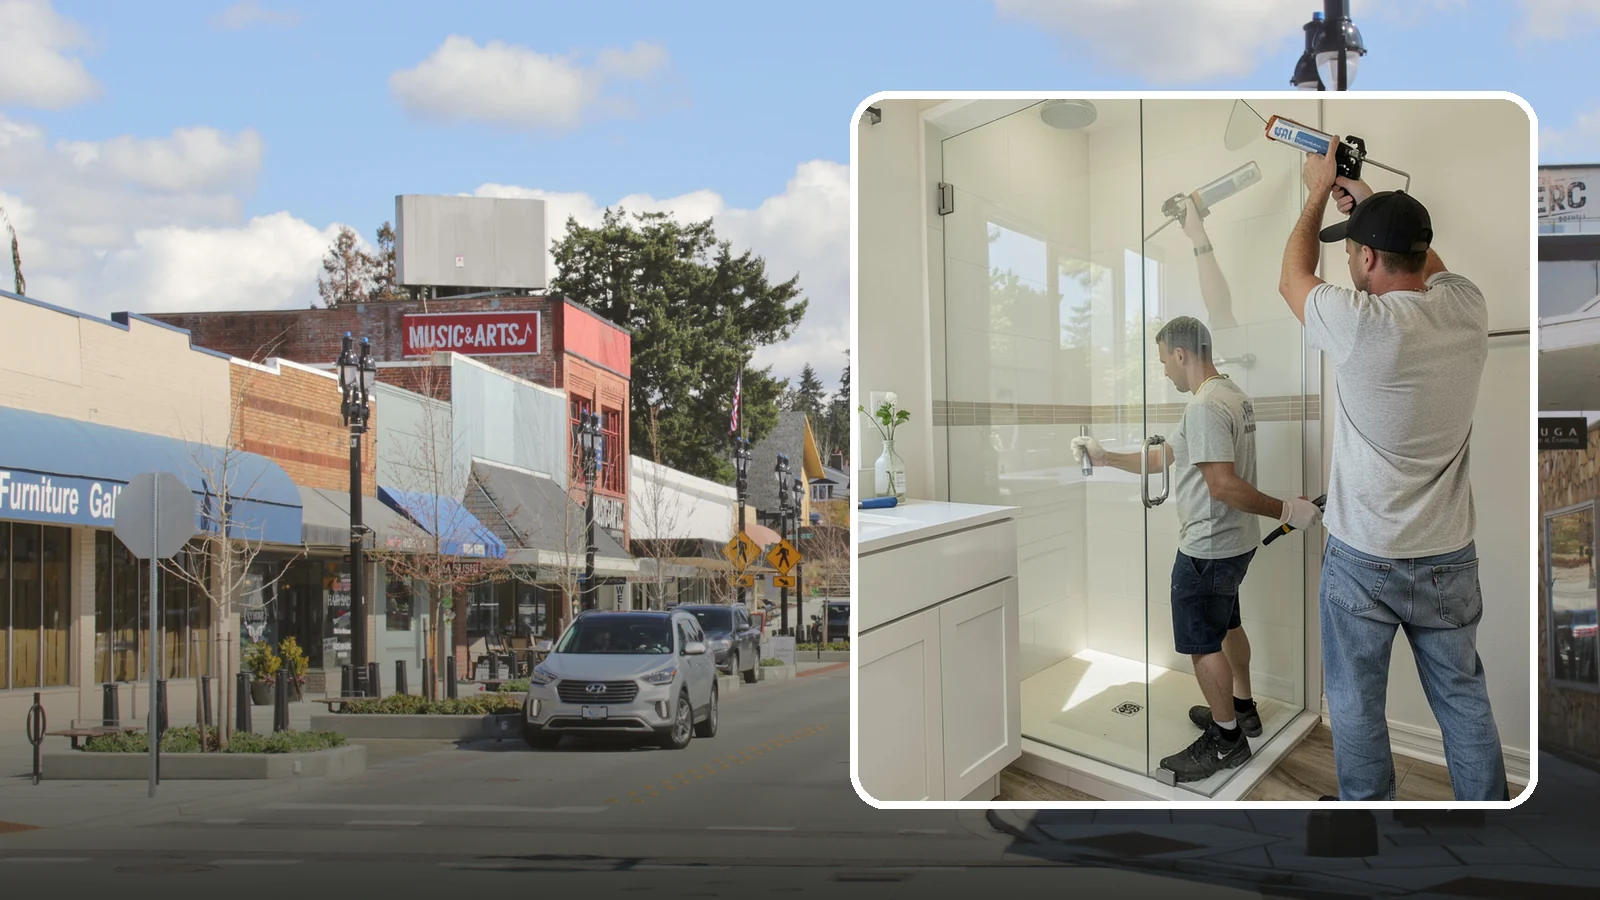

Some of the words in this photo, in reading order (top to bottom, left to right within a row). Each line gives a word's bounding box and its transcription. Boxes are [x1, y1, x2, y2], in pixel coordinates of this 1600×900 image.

[408, 323, 519, 349] MUSIC&ARTS
[1540, 427, 1577, 437] UGA
[0, 471, 79, 515] Furniture
[89, 482, 122, 519] Gal
